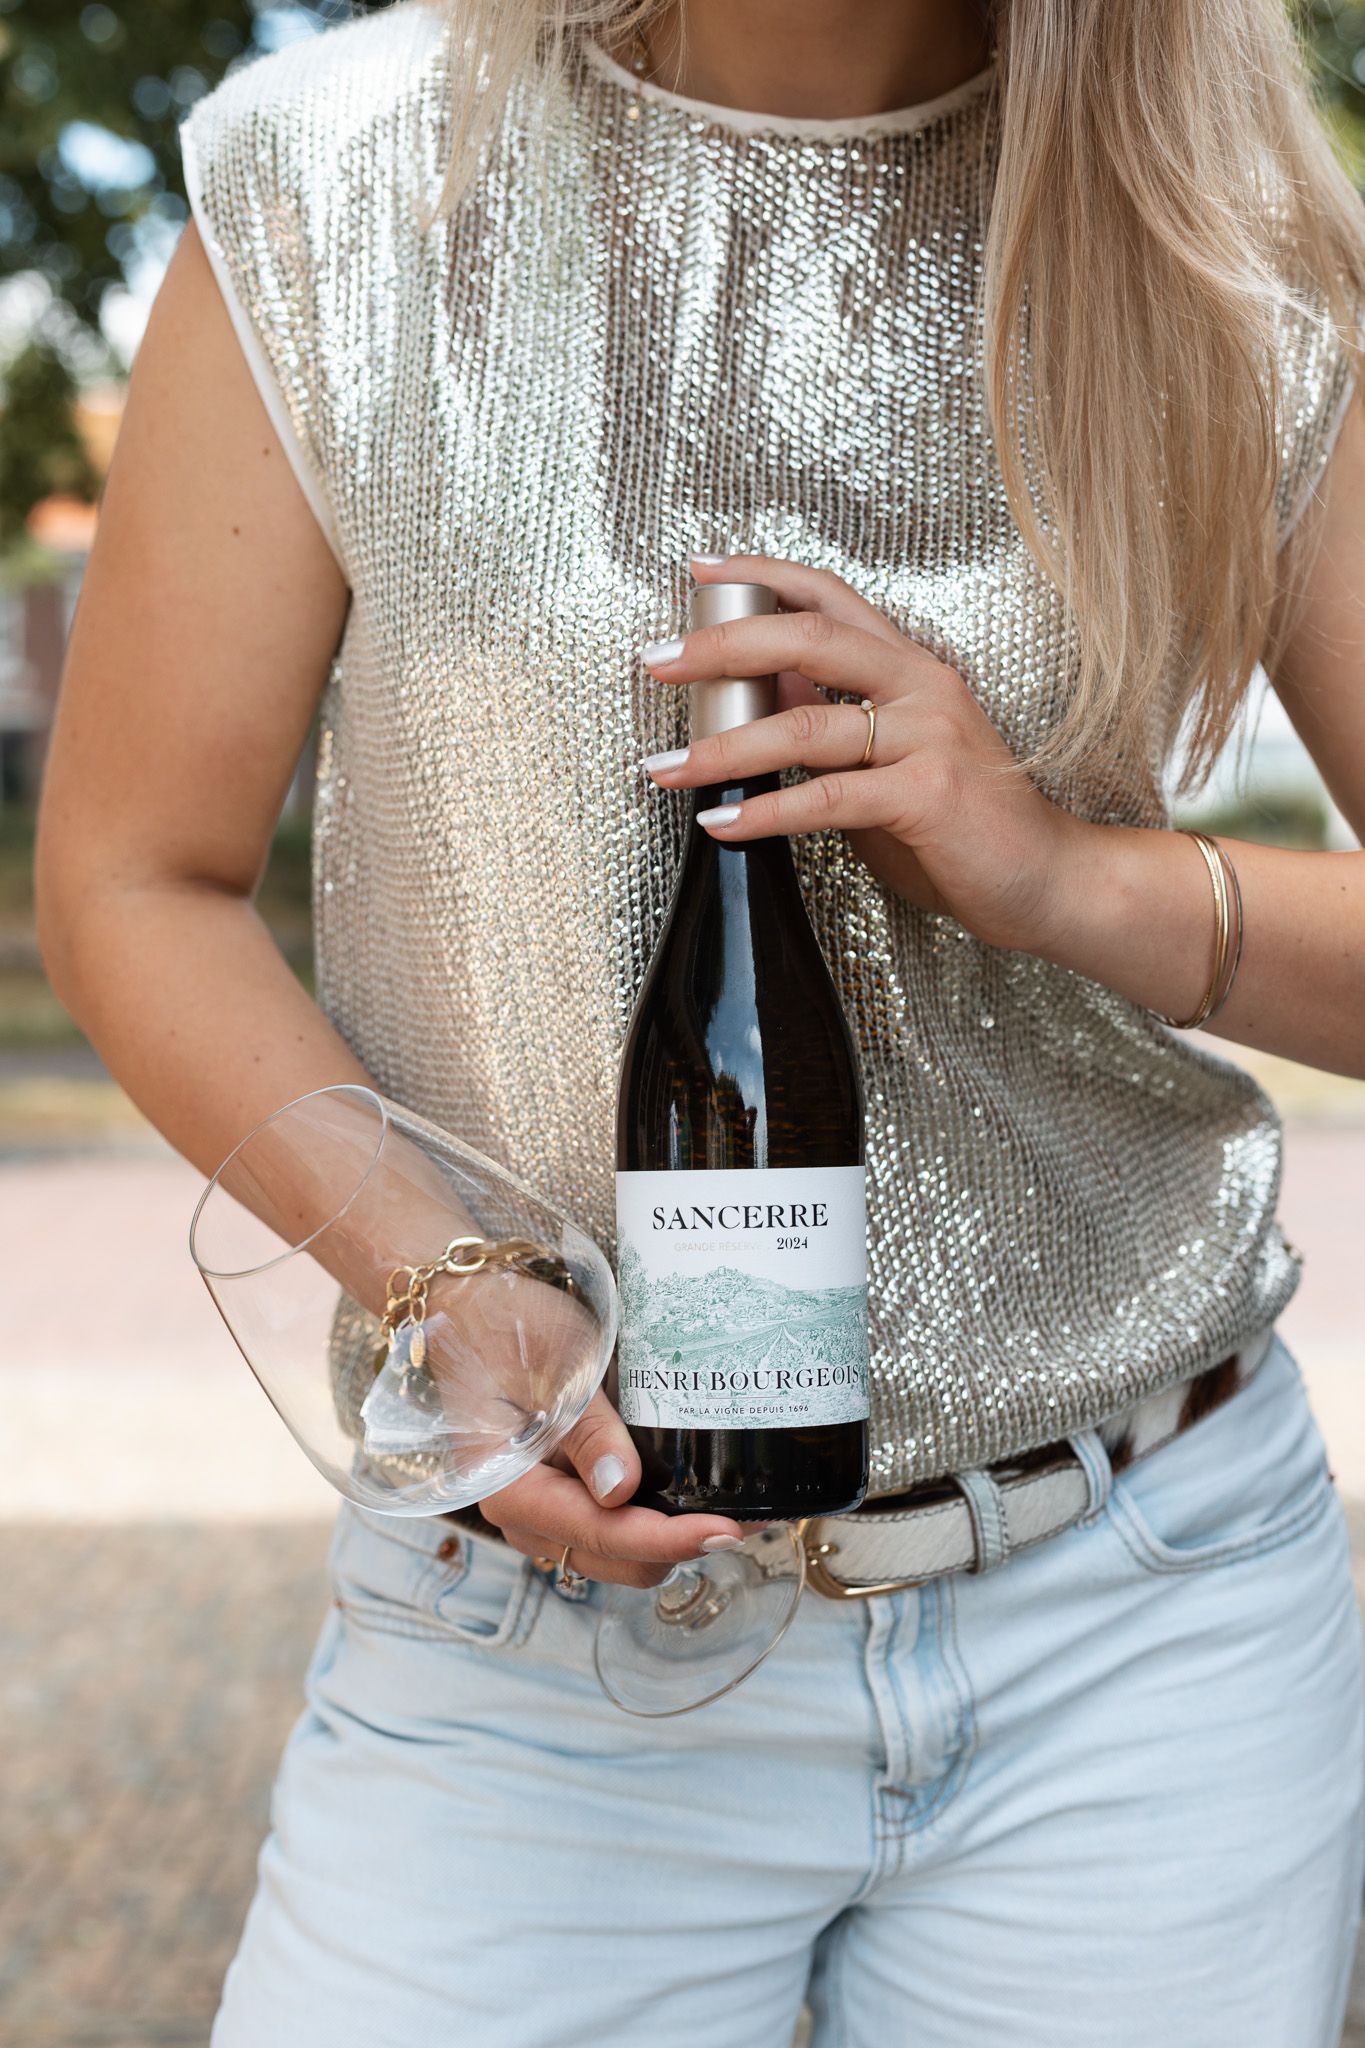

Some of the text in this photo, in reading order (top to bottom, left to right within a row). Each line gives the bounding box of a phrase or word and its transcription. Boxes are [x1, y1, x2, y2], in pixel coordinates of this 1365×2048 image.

[652, 1203, 829, 1230] SANCERRE
[673, 1242, 715, 1252] GRANDE
[776, 1236, 808, 1250] 2024
[629, 1364, 859, 1391] HENRI BOURGEOIS
[679, 1404, 809, 1415] PAR LA VIGNE DEPUIS 1696
